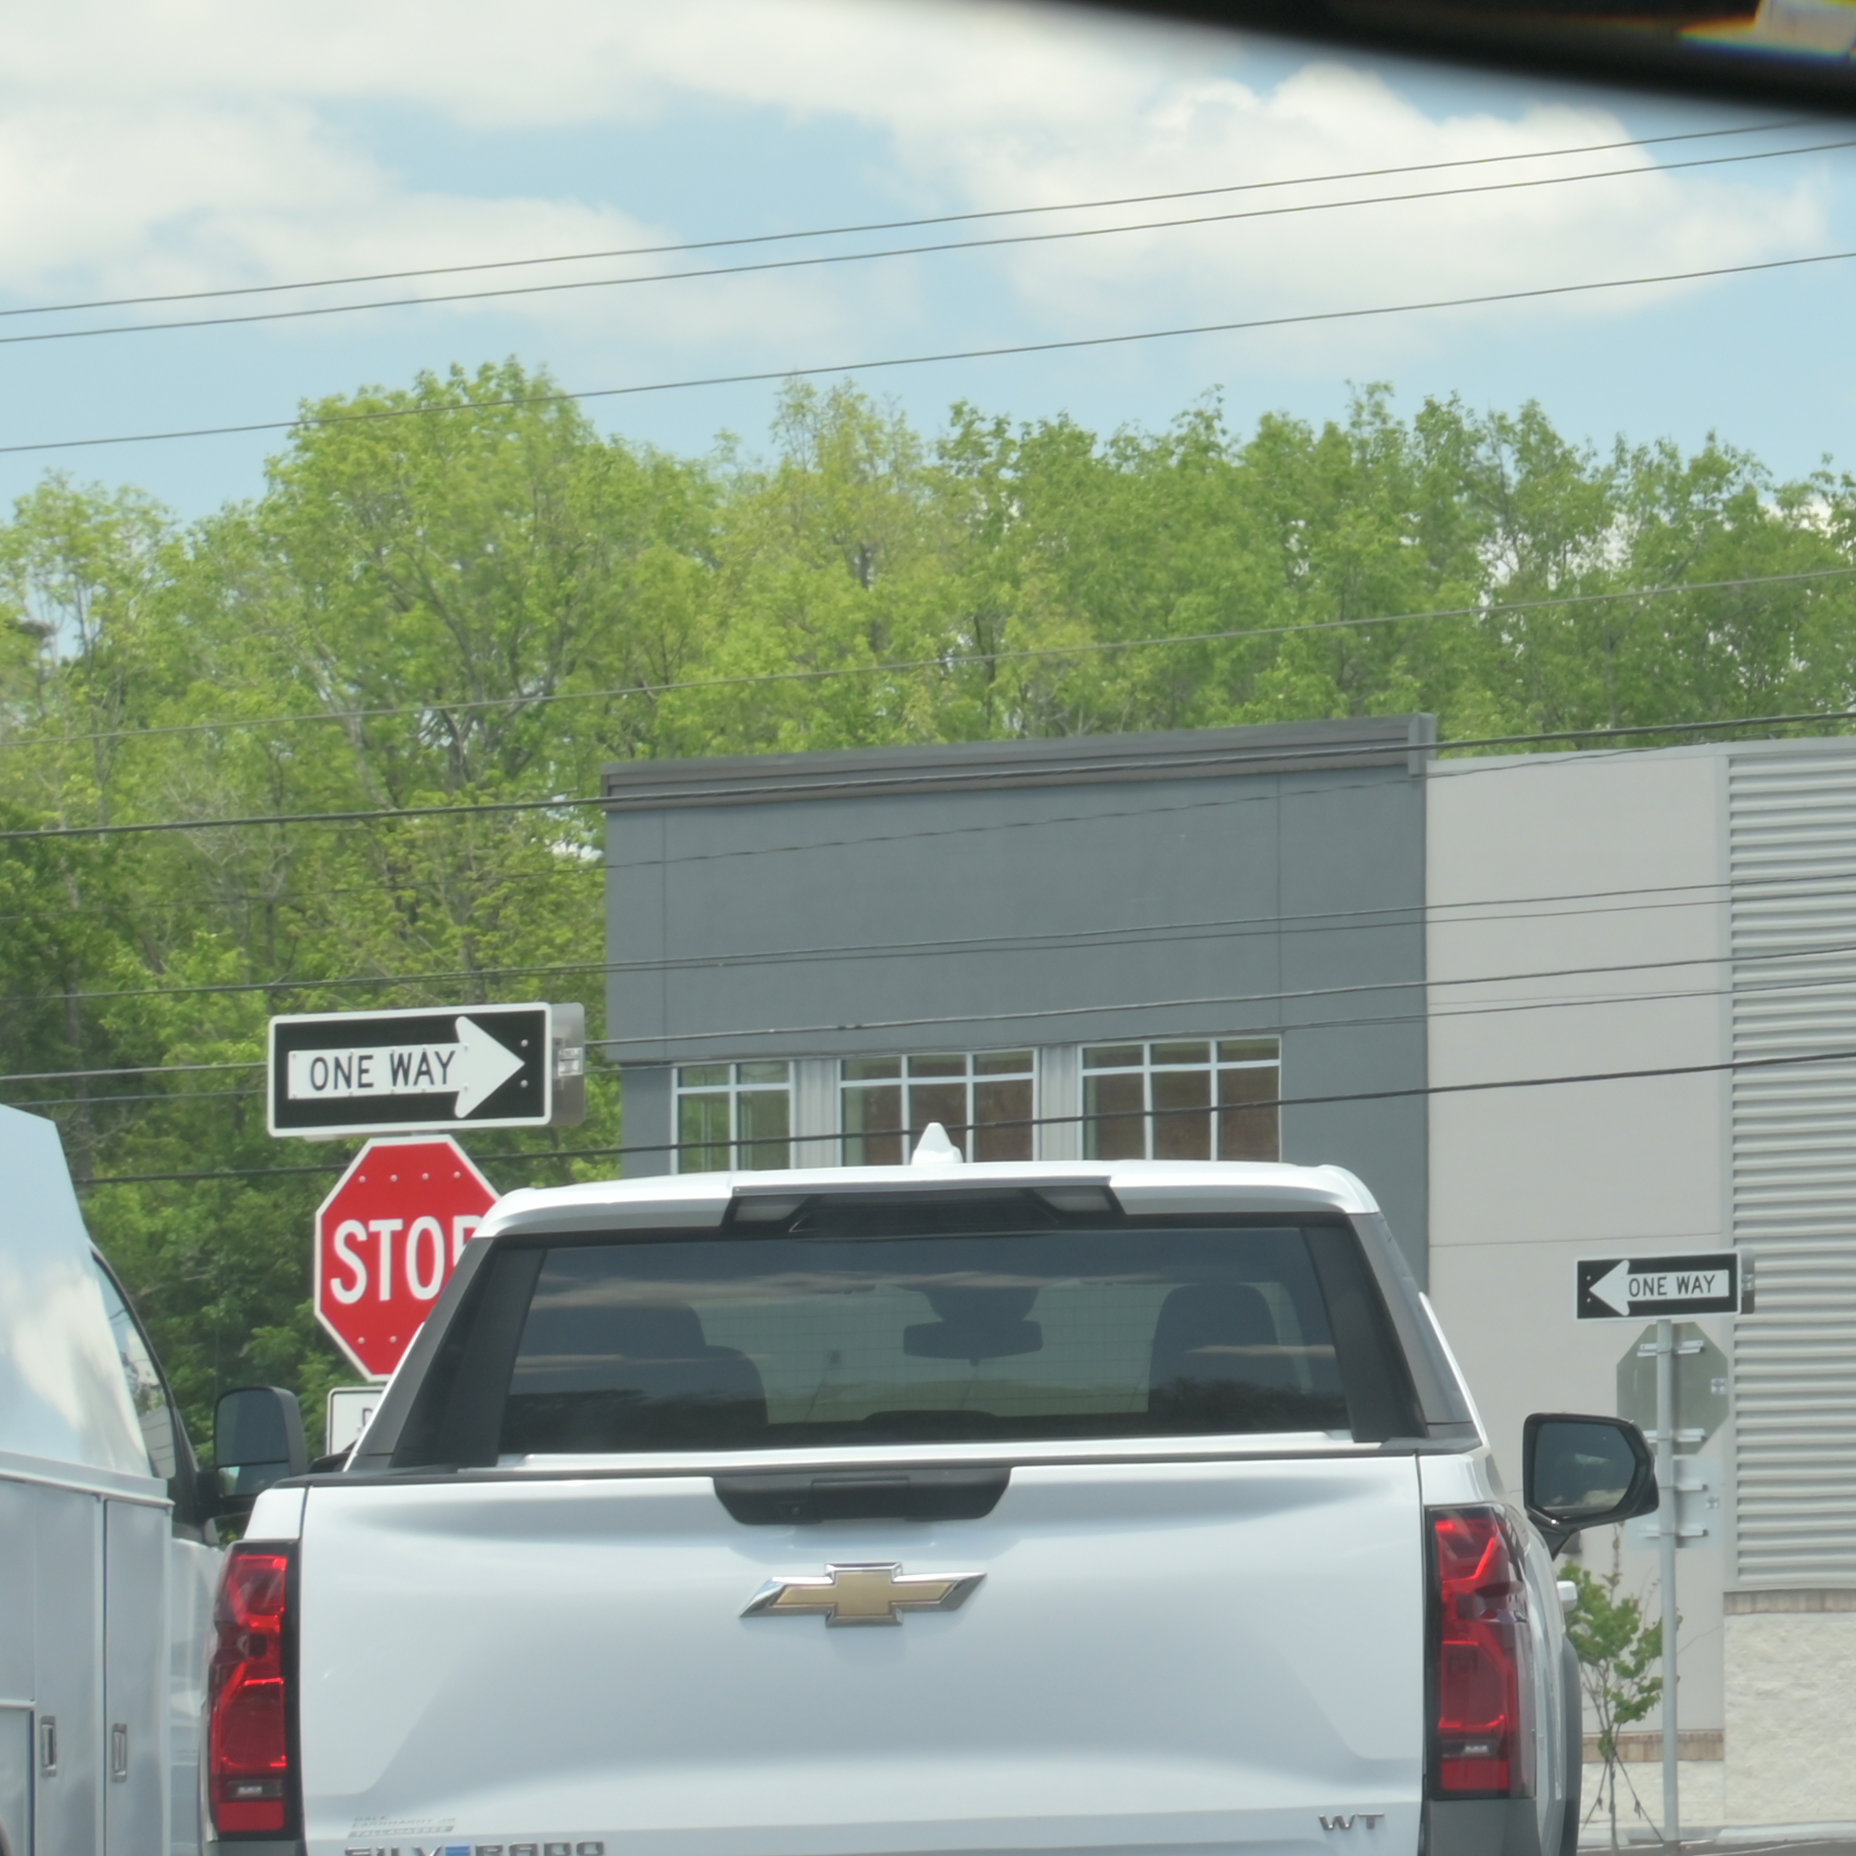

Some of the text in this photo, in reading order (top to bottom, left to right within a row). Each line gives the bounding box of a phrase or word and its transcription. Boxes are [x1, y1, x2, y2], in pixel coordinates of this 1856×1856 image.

[310, 1050, 456, 1092] ONE WAY
[1628, 1274, 1716, 1298] ONE WAY
[1318, 1812, 1385, 1832] WT
